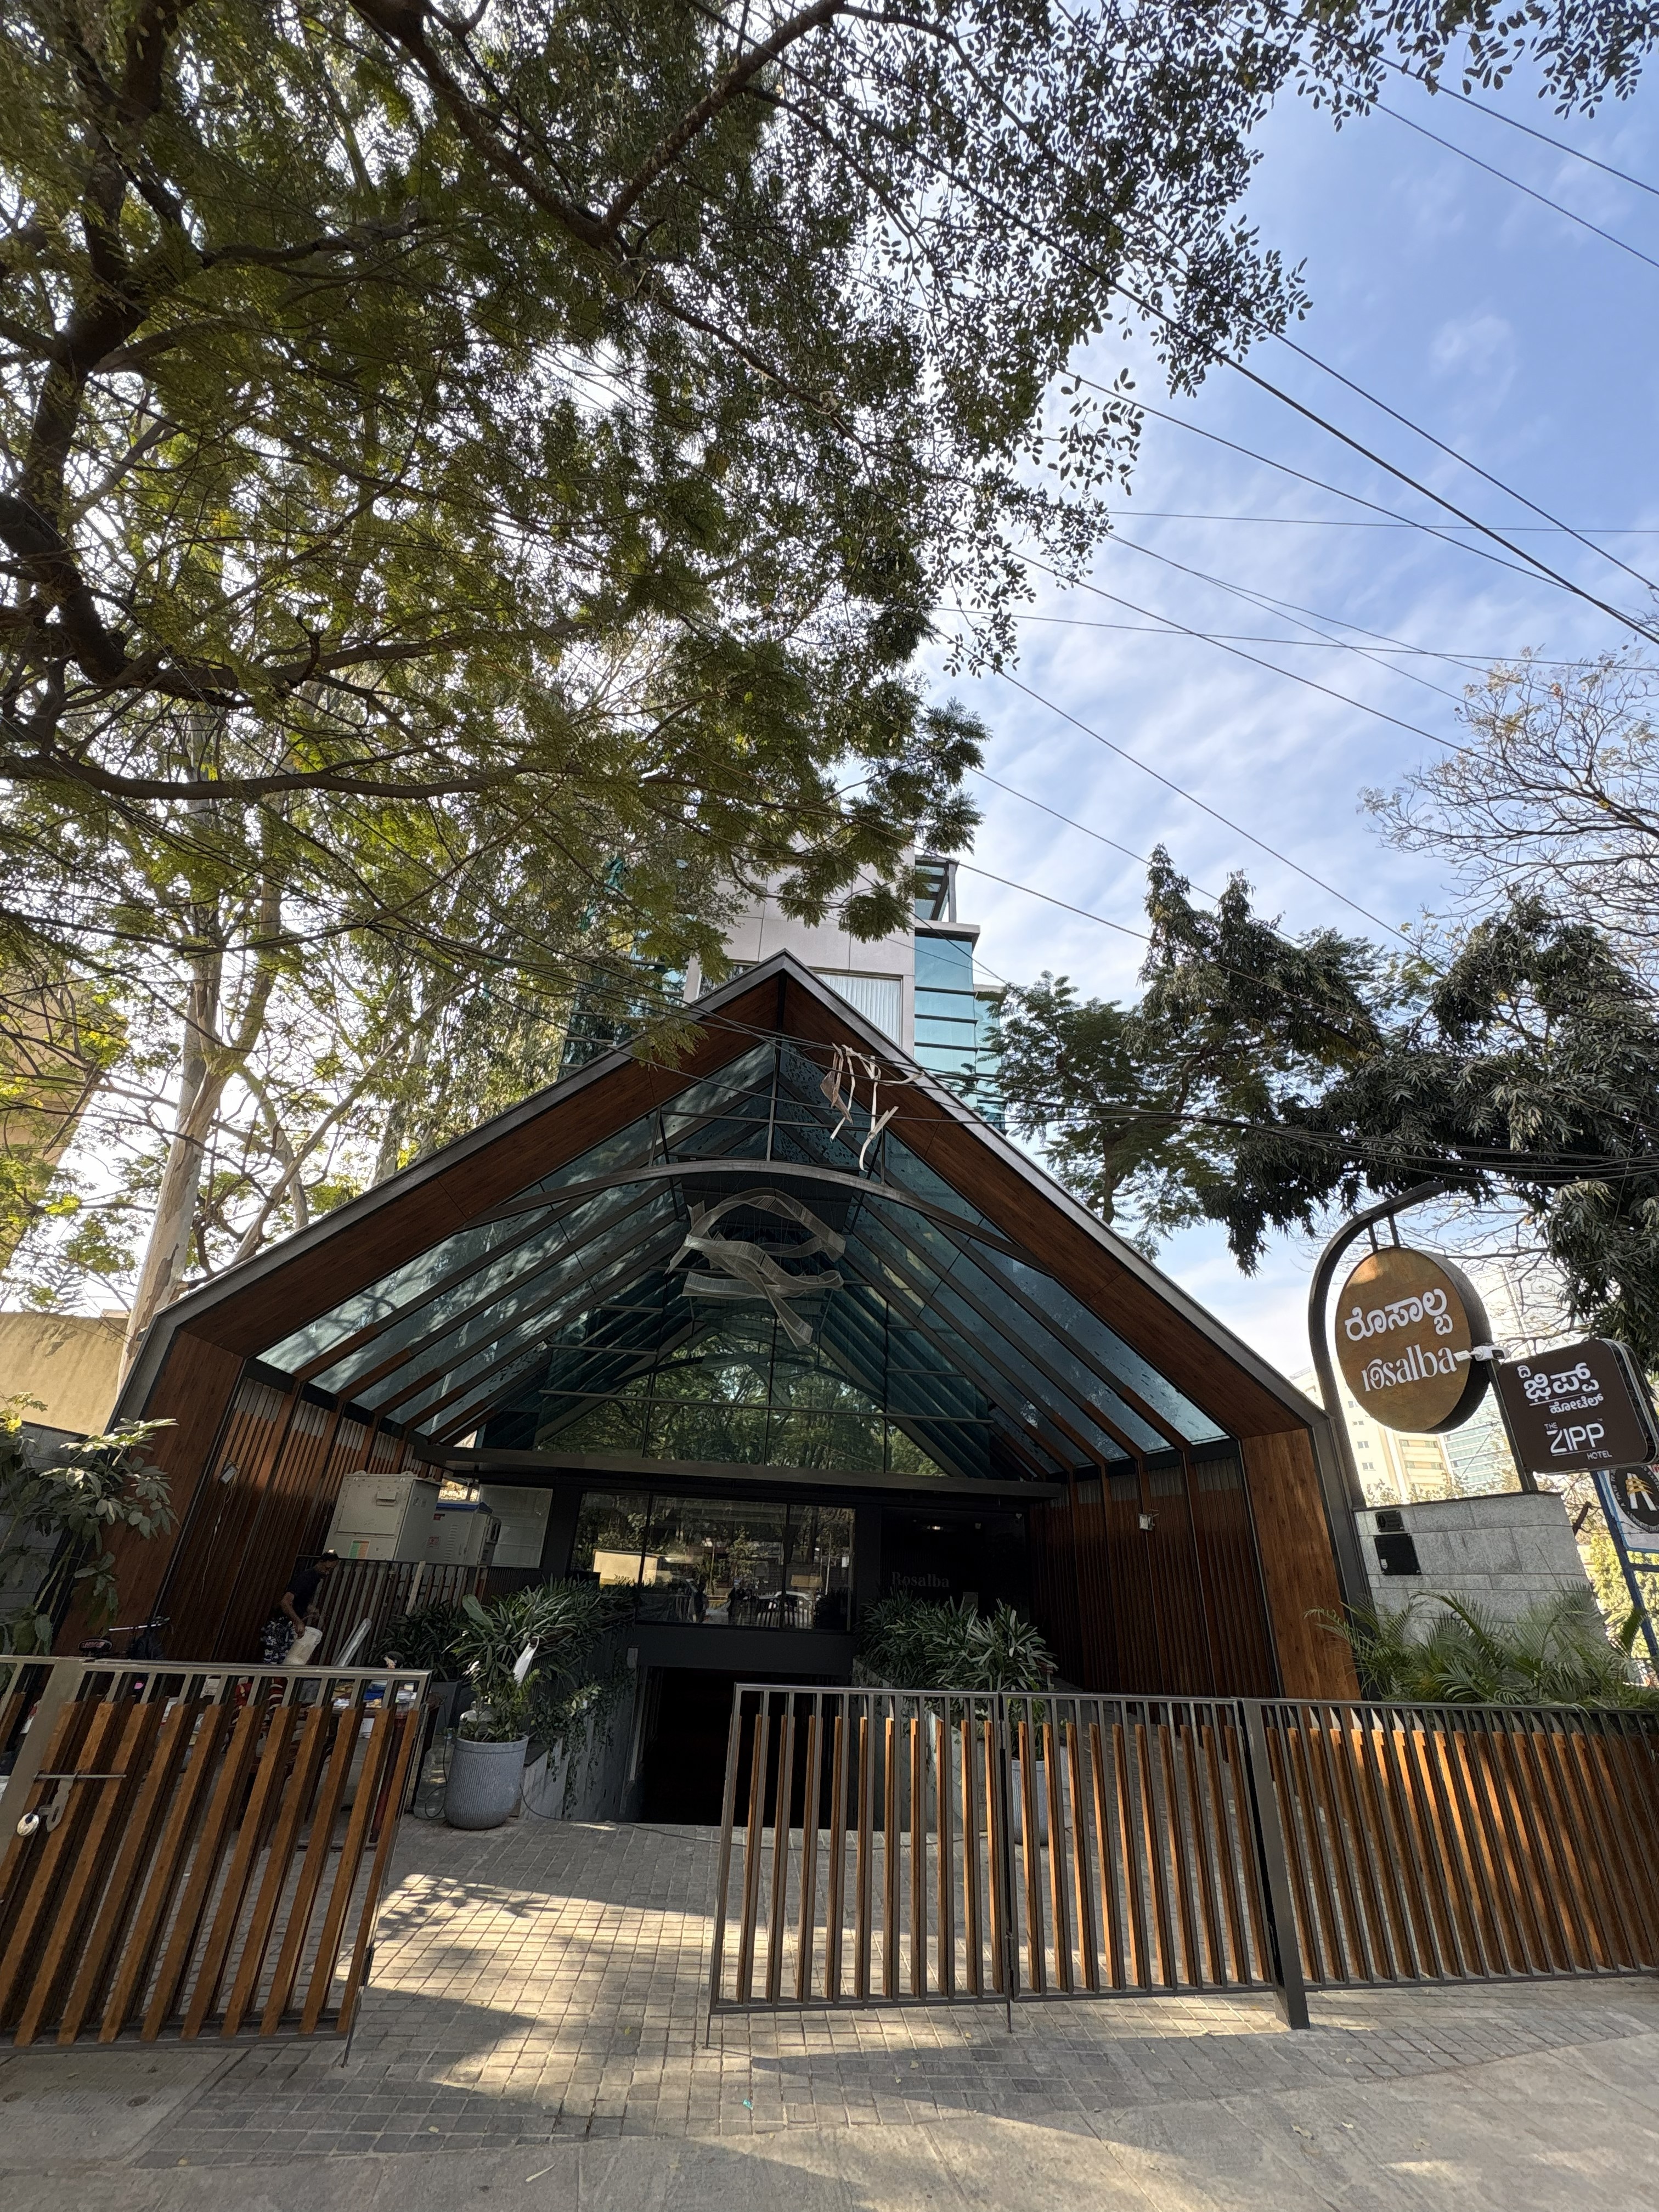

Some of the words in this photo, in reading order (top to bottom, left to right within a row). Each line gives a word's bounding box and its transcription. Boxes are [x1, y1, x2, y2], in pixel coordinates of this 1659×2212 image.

[1345, 1288, 1453, 1341] ರೊಸಾಲ್ಬ
[1361, 1344, 1457, 1392] rosalba
[1517, 1365, 1531, 1379] ದಿ
[1549, 1393, 1604, 1414] ಹೋಟೆಲ್
[1544, 1422, 1558, 1430] THE
[1546, 1423, 1605, 1453] ZIPP
[1587, 1450, 1612, 1460] HOTEL
[891, 1571, 950, 1588] Rosalba
